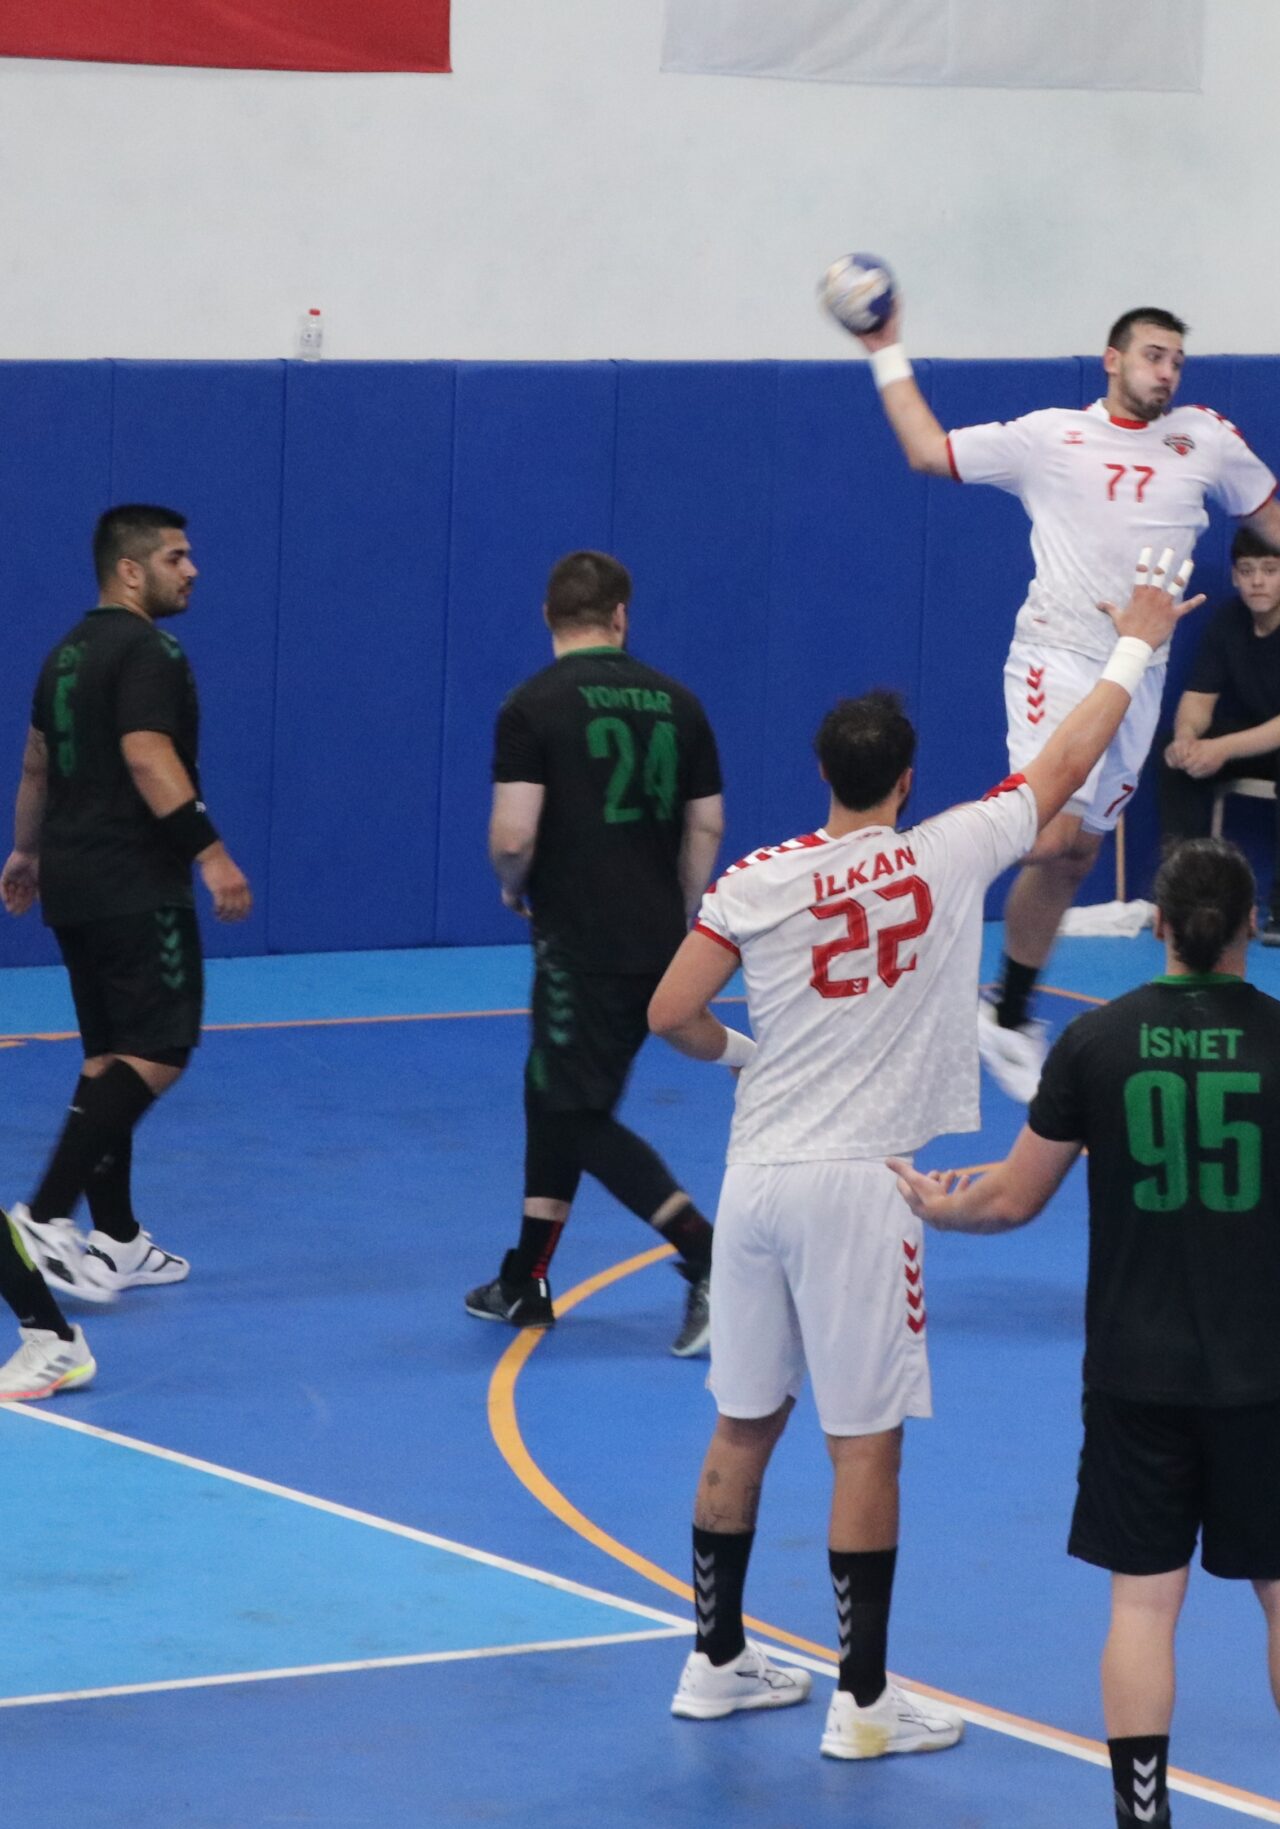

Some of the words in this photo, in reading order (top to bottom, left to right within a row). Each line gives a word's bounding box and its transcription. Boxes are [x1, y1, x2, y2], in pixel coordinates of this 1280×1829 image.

[1104, 463, 1156, 503] 77
[586, 716, 678, 825] 24
[813, 846, 917, 902] İLKAN
[808, 874, 934, 998] 22
[1139, 1022, 1245, 1060] İSMET
[1124, 1070, 1262, 1213] 95
